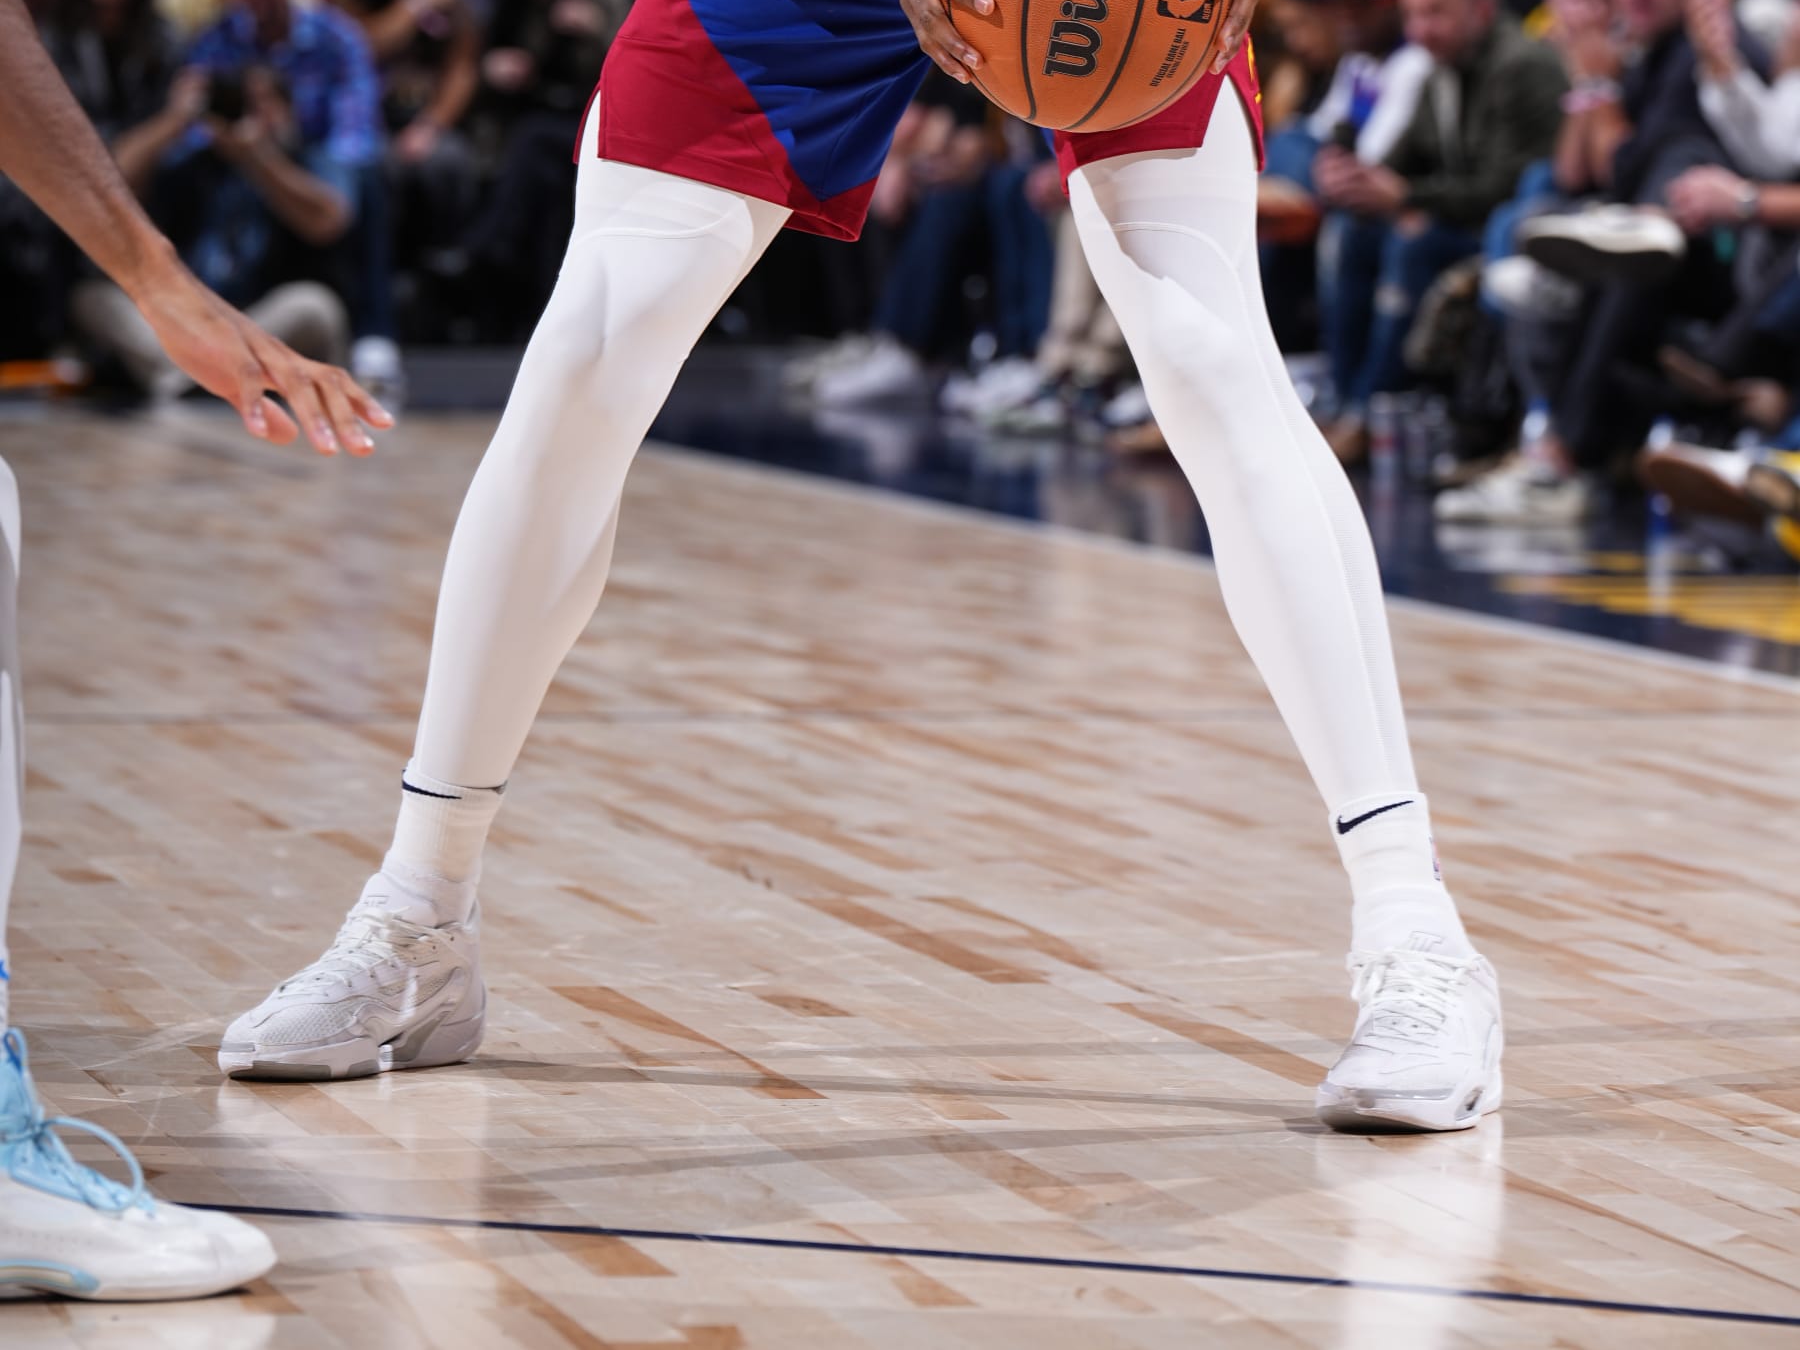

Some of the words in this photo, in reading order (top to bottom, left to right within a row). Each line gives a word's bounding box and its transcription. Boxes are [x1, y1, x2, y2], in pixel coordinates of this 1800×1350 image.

[1150, 62, 1169, 87] OFFICIAL
[1165, 43, 1180, 61] GAME
[1173, 27, 1187, 44] BALL
